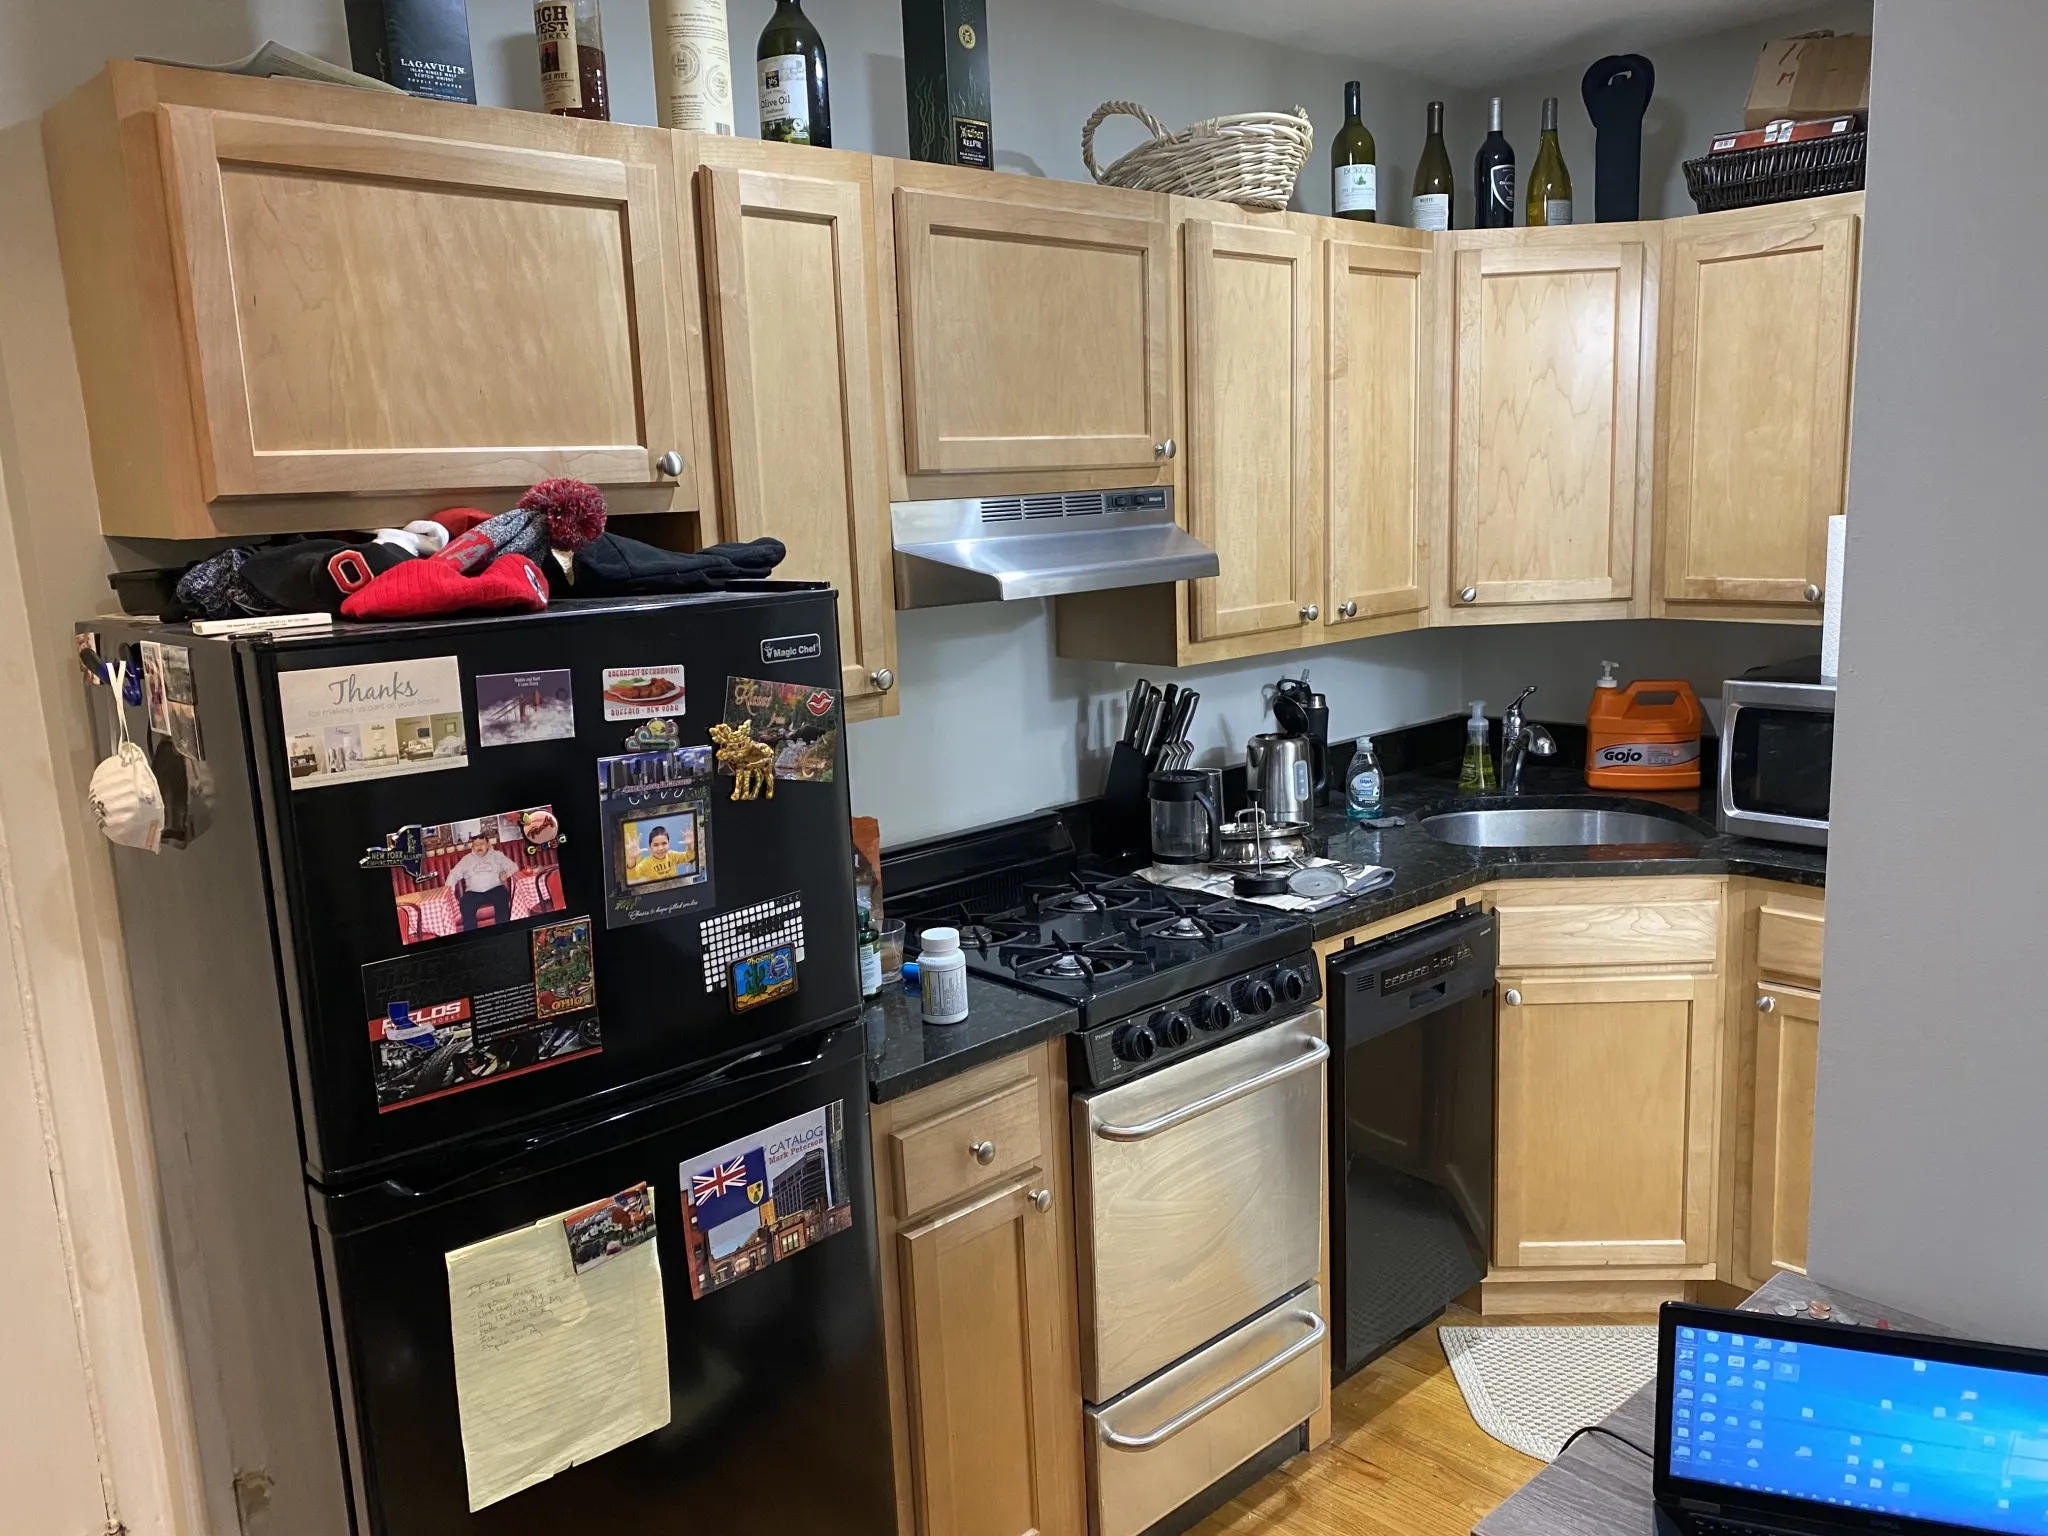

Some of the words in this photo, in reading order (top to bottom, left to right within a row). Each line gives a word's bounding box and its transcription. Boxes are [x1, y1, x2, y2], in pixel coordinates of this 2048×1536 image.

[401, 59, 465, 75] LAGAVULIN
[761, 98, 777, 109] Olive
[779, 95, 790, 105] Oil
[328, 550, 374, 595] O
[773, 647, 797, 658] Magic
[798, 643, 816, 654] Chef
[328, 672, 418, 705] Thanks
[387, 851, 403, 860] YORK
[552, 996, 585, 1010] OHIO
[769, 1125, 824, 1156] CATALOG
[768, 1150, 789, 1165] Mark
[790, 1137, 824, 1157] Peterson
